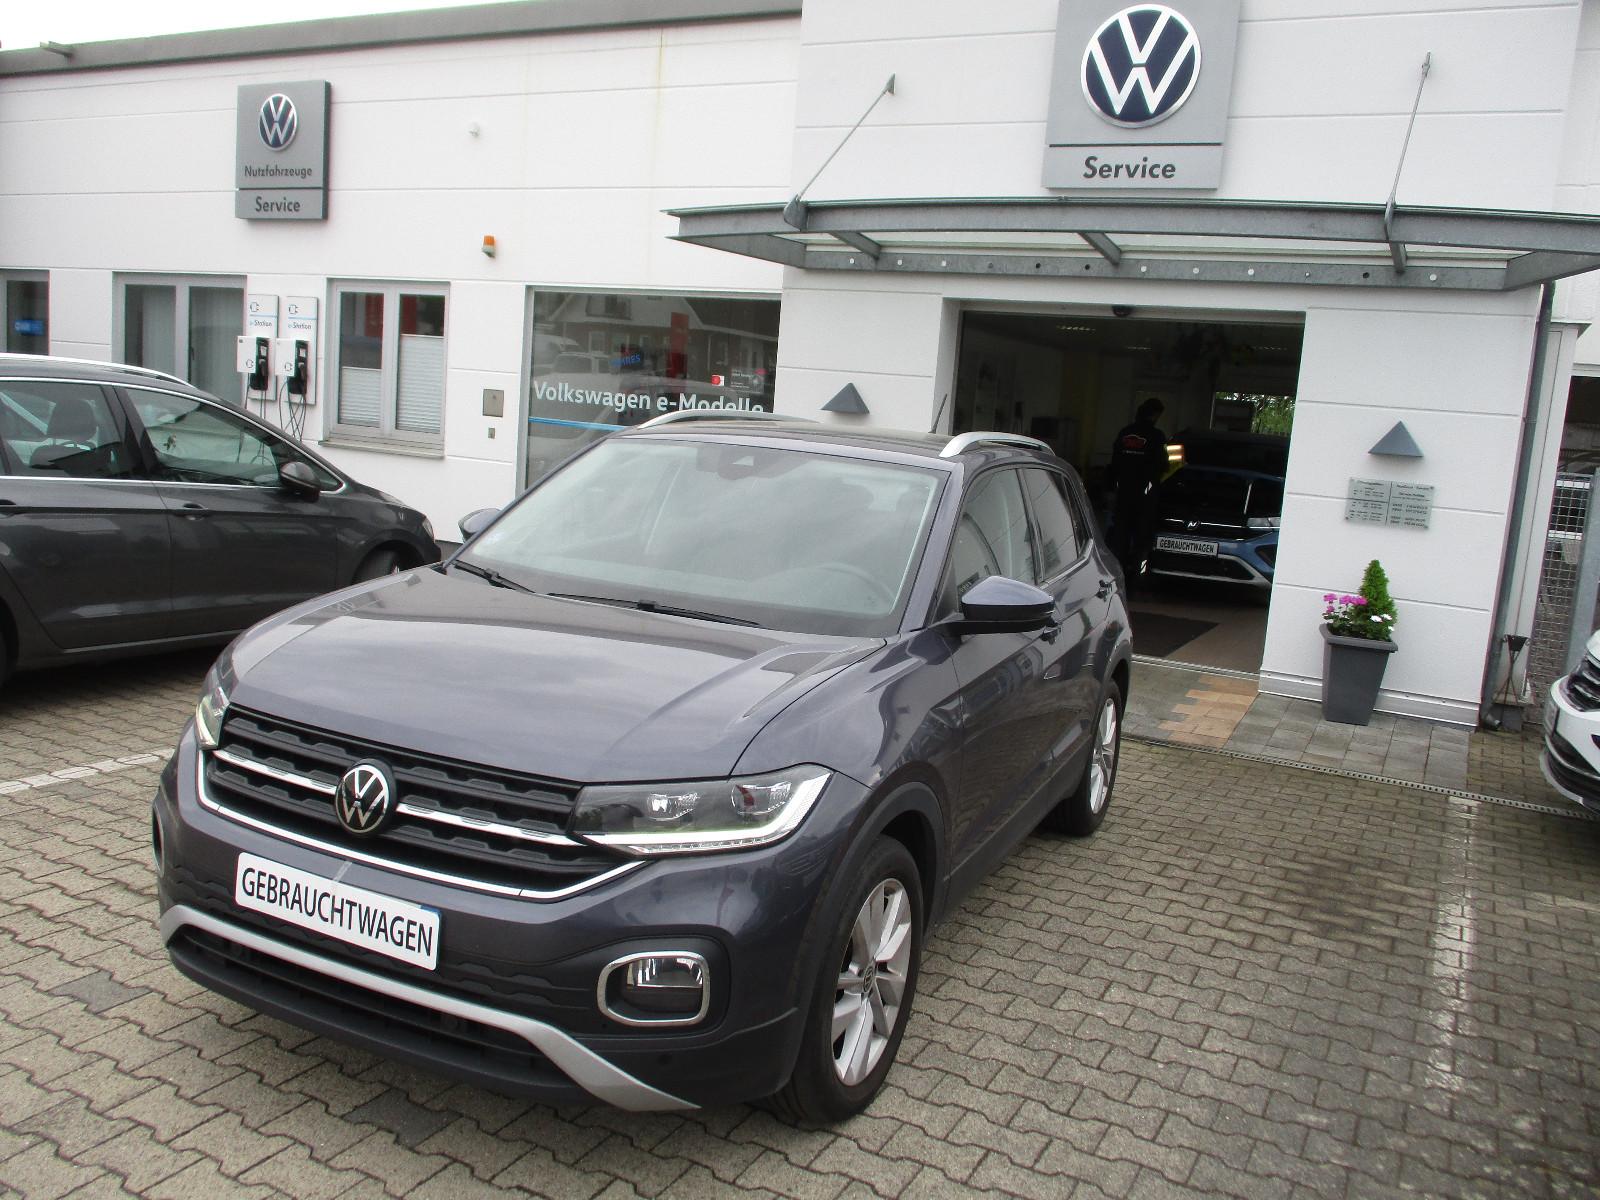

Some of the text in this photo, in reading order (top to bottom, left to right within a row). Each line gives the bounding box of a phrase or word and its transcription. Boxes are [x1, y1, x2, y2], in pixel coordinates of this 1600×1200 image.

[1081, 4, 1202, 128] VW
[244, 165, 313, 179] Nutzfahrzeuge
[1083, 155, 1176, 179] Service
[255, 195, 301, 212] Service
[533, 380, 651, 413] Volkswagen
[1160, 539, 1215, 553] GEBRAUCHTWAGEN
[242, 867, 433, 957] GEBRAUCHTWAGEN
